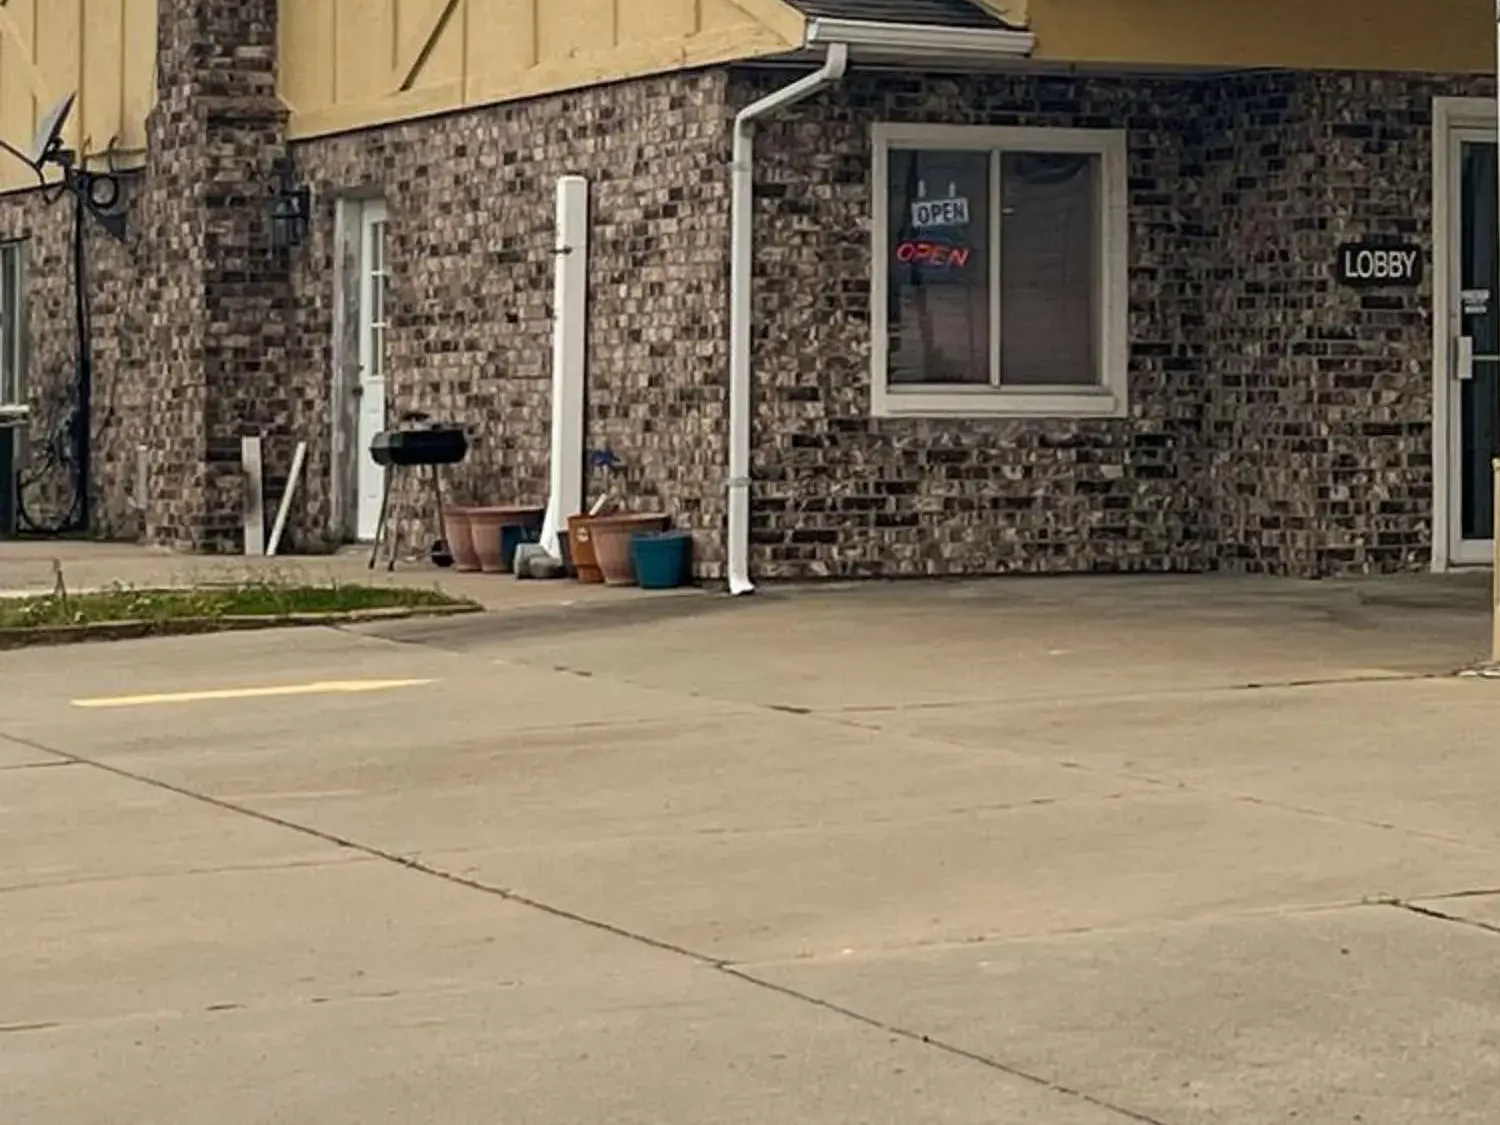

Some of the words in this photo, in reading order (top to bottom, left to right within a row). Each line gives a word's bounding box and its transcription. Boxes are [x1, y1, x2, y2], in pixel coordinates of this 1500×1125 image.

[917, 201, 965, 224] OPEN
[896, 242, 969, 267] OPEN
[1344, 250, 1417, 278] LOBBY
